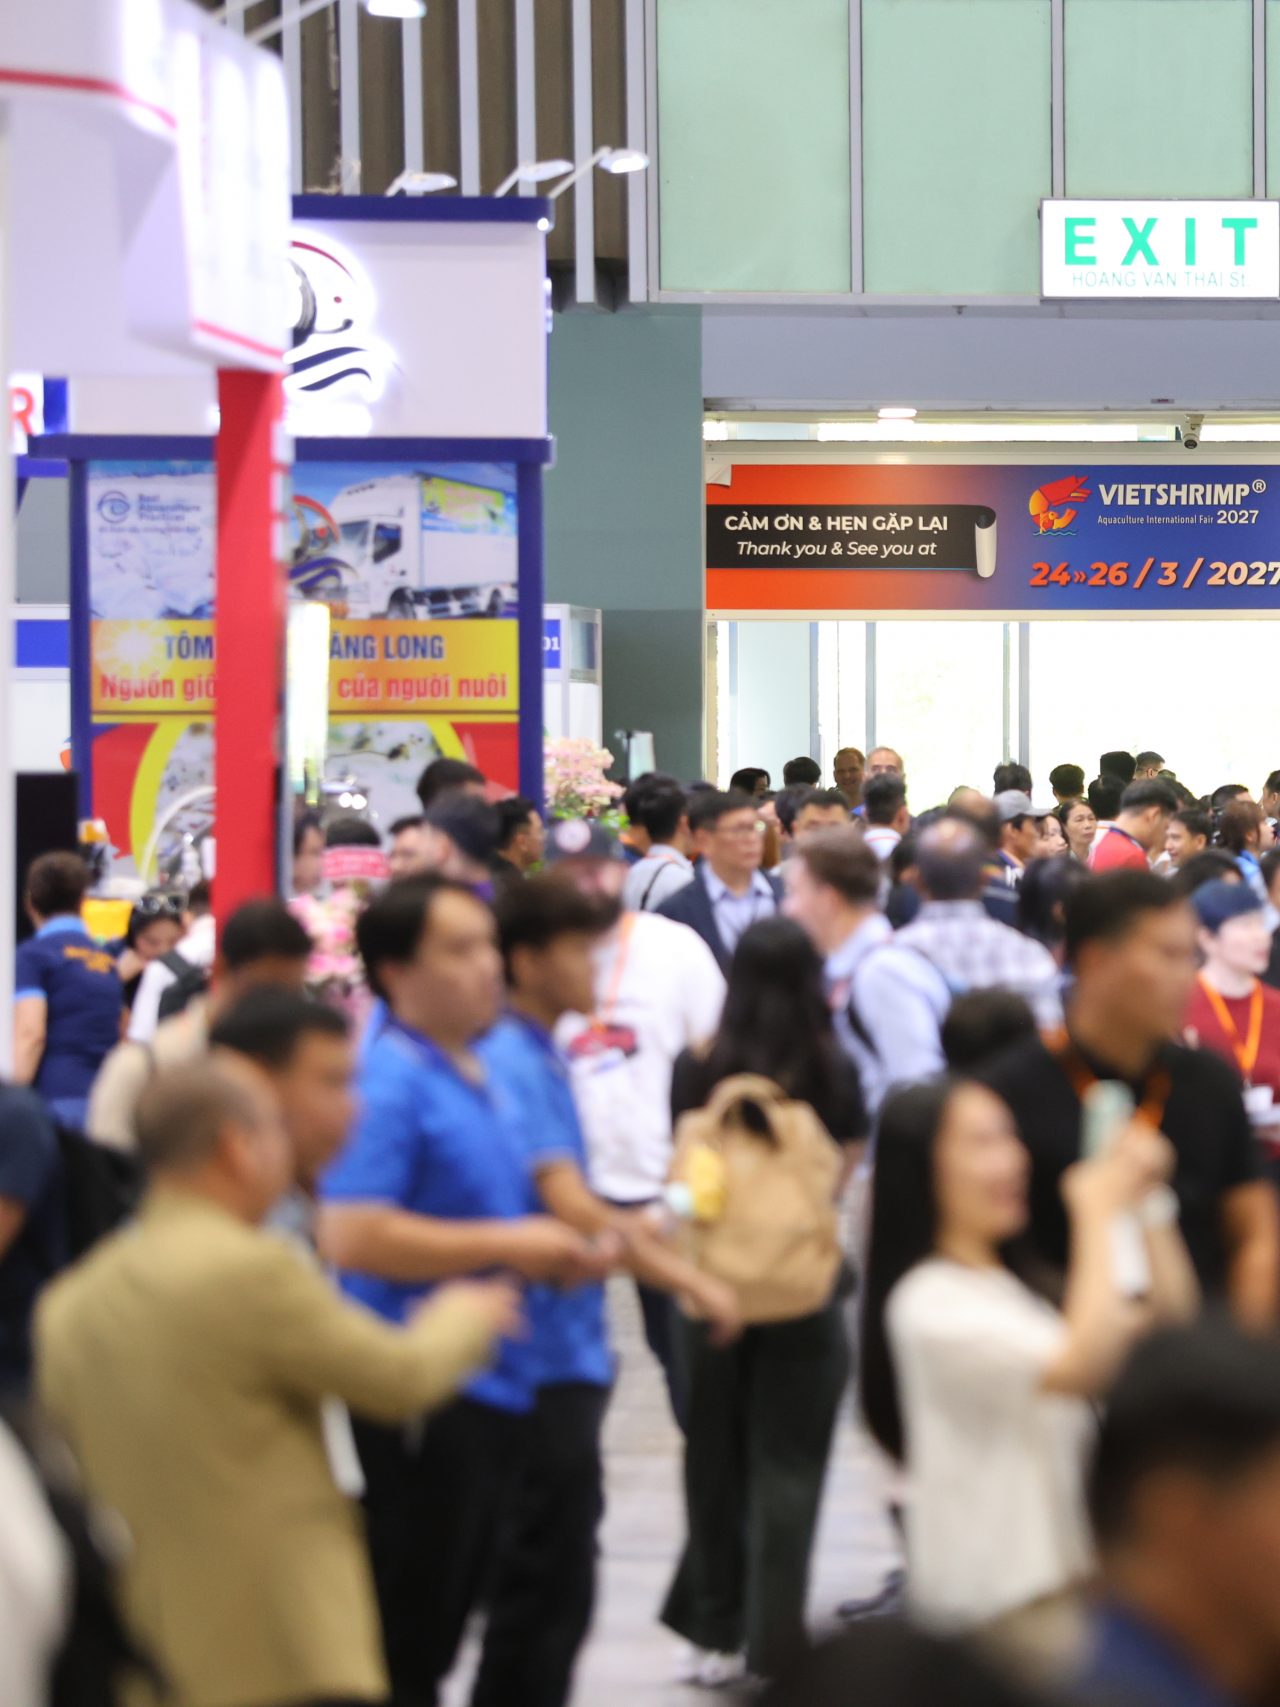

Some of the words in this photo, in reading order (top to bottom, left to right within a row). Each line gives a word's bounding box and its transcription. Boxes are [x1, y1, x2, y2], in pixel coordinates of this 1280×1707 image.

[1064, 217, 1259, 266] EXIT
[1072, 271, 1137, 288] HOANG
[1143, 271, 1177, 288] VAN
[1185, 271, 1224, 288] THAI
[724, 510, 770, 531] CẢM
[774, 513, 804, 531] ƠN
[808, 515, 822, 531] &
[827, 515, 868, 534] HẸN
[872, 512, 913, 534] GẶP
[918, 515, 949, 534] LẠI
[1097, 514, 1145, 526] Aquaculture
[1146, 514, 1197, 524] International
[1199, 514, 1214, 524] Fair
[1216, 509, 1260, 525] 2027
[736, 541, 793, 556] Thank
[793, 545, 829, 559] you
[831, 541, 844, 556] &
[846, 541, 878, 556] See
[880, 545, 914, 559] you
[918, 542, 937, 556] at
[164, 631, 214, 660] TÔM
[384, 635, 445, 660] LONG
[458, 673, 508, 700] nuôi
